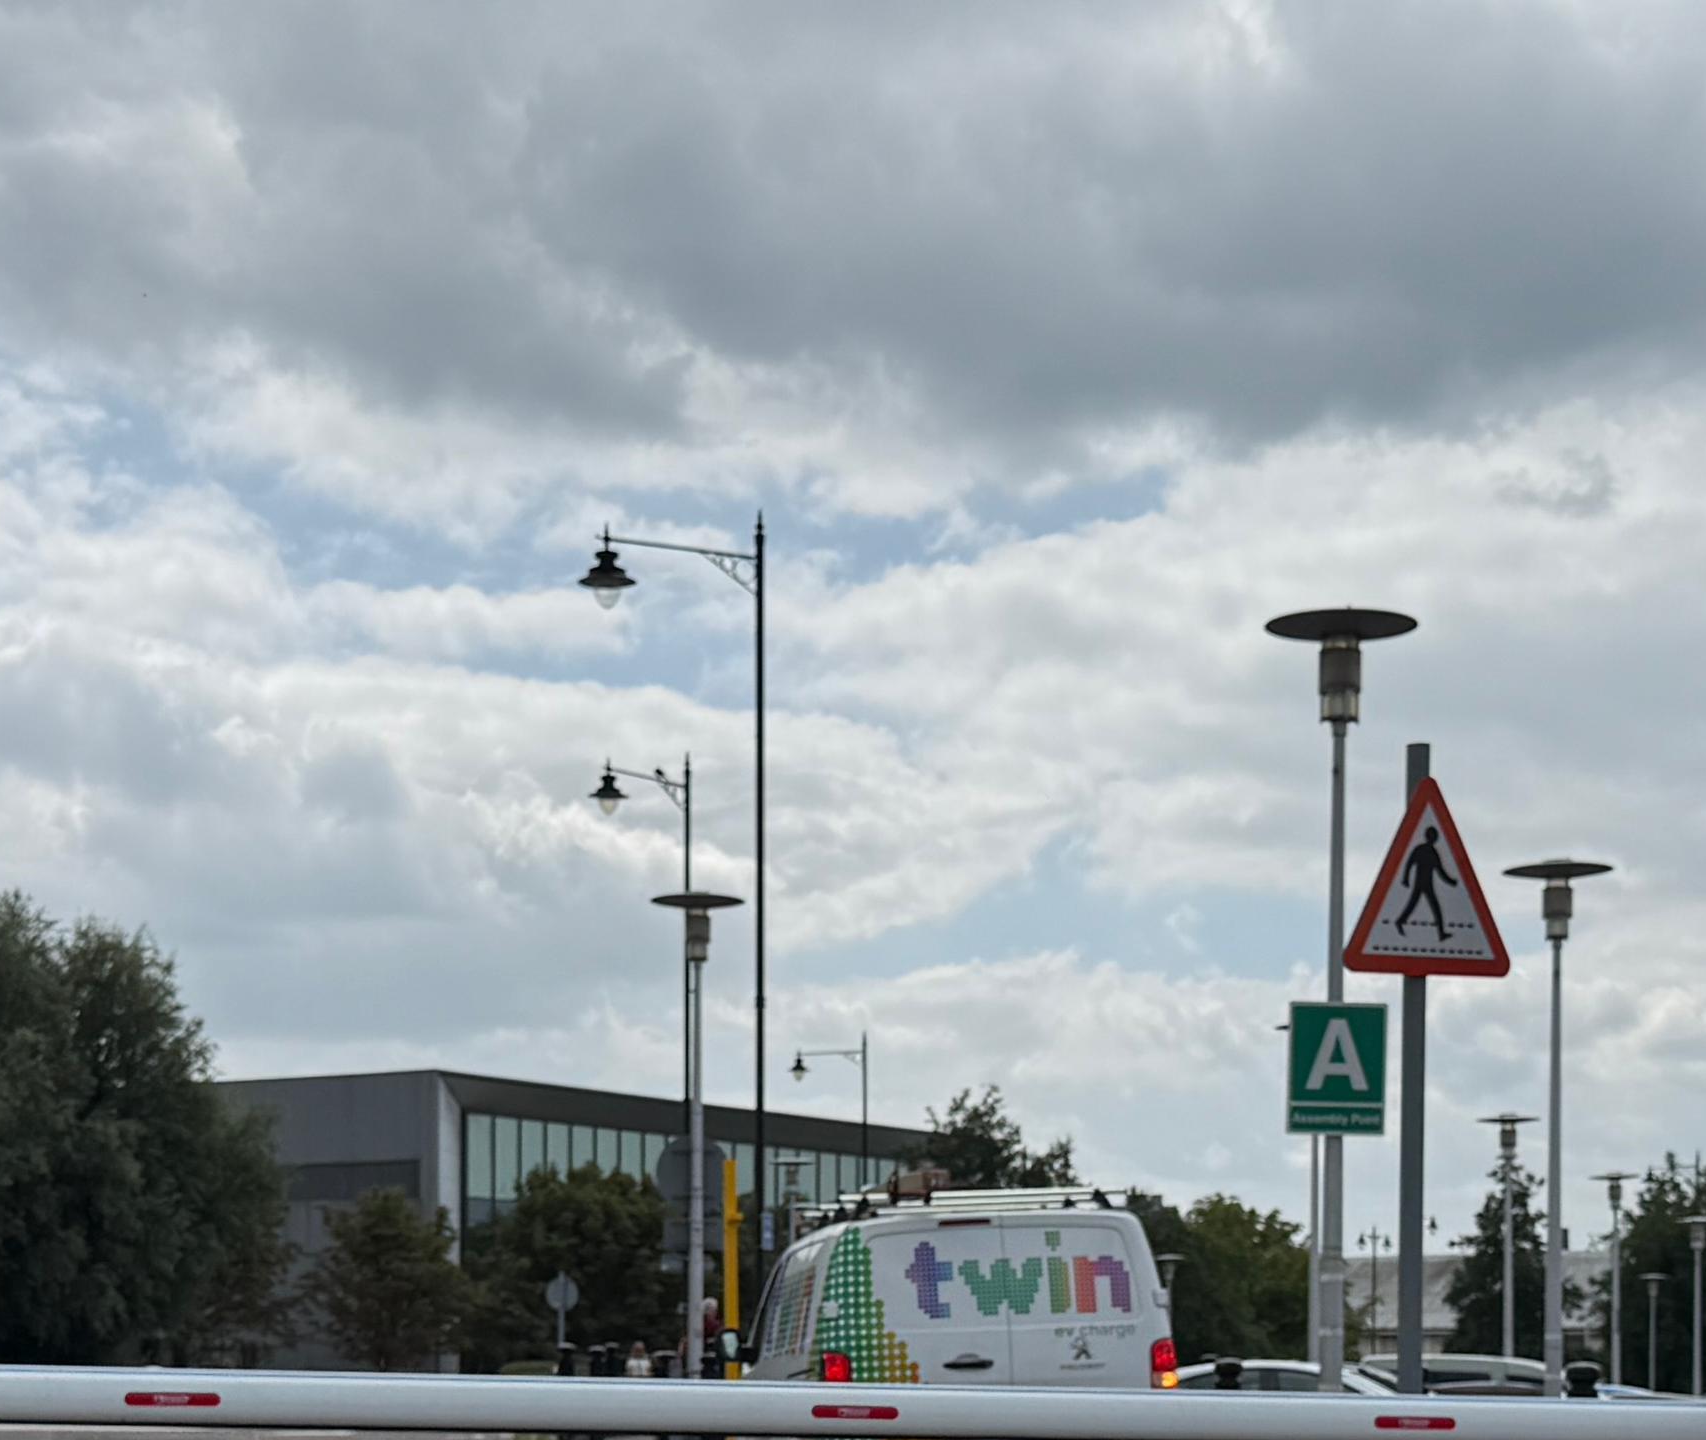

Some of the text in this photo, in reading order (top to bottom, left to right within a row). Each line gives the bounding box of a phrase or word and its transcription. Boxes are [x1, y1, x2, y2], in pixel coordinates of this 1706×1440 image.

[1305, 1018, 1369, 1092] A
[905, 1230, 1132, 1319] twin
[1079, 1323, 1136, 1339] charge
